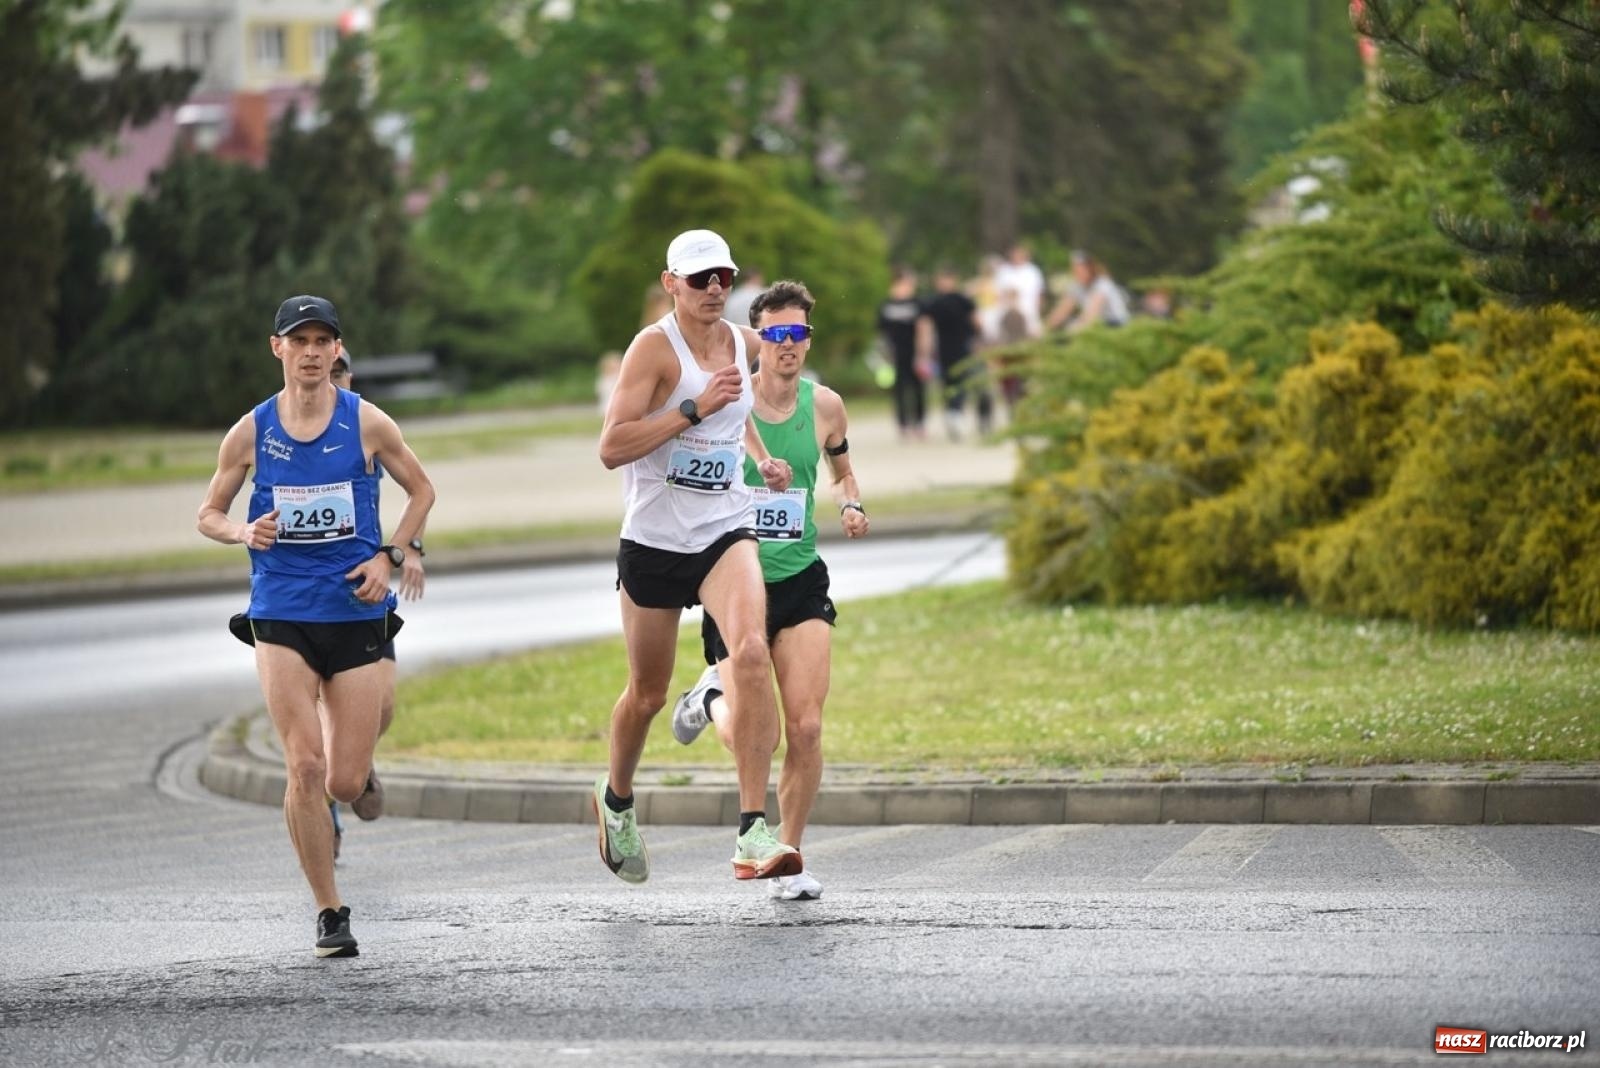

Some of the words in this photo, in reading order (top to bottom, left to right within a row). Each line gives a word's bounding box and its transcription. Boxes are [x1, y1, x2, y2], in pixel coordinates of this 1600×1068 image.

[687, 459, 725, 479] 220
[321, 484, 346, 493] GRANIC
[292, 508, 336, 528] 249
[755, 508, 788, 527] 158
